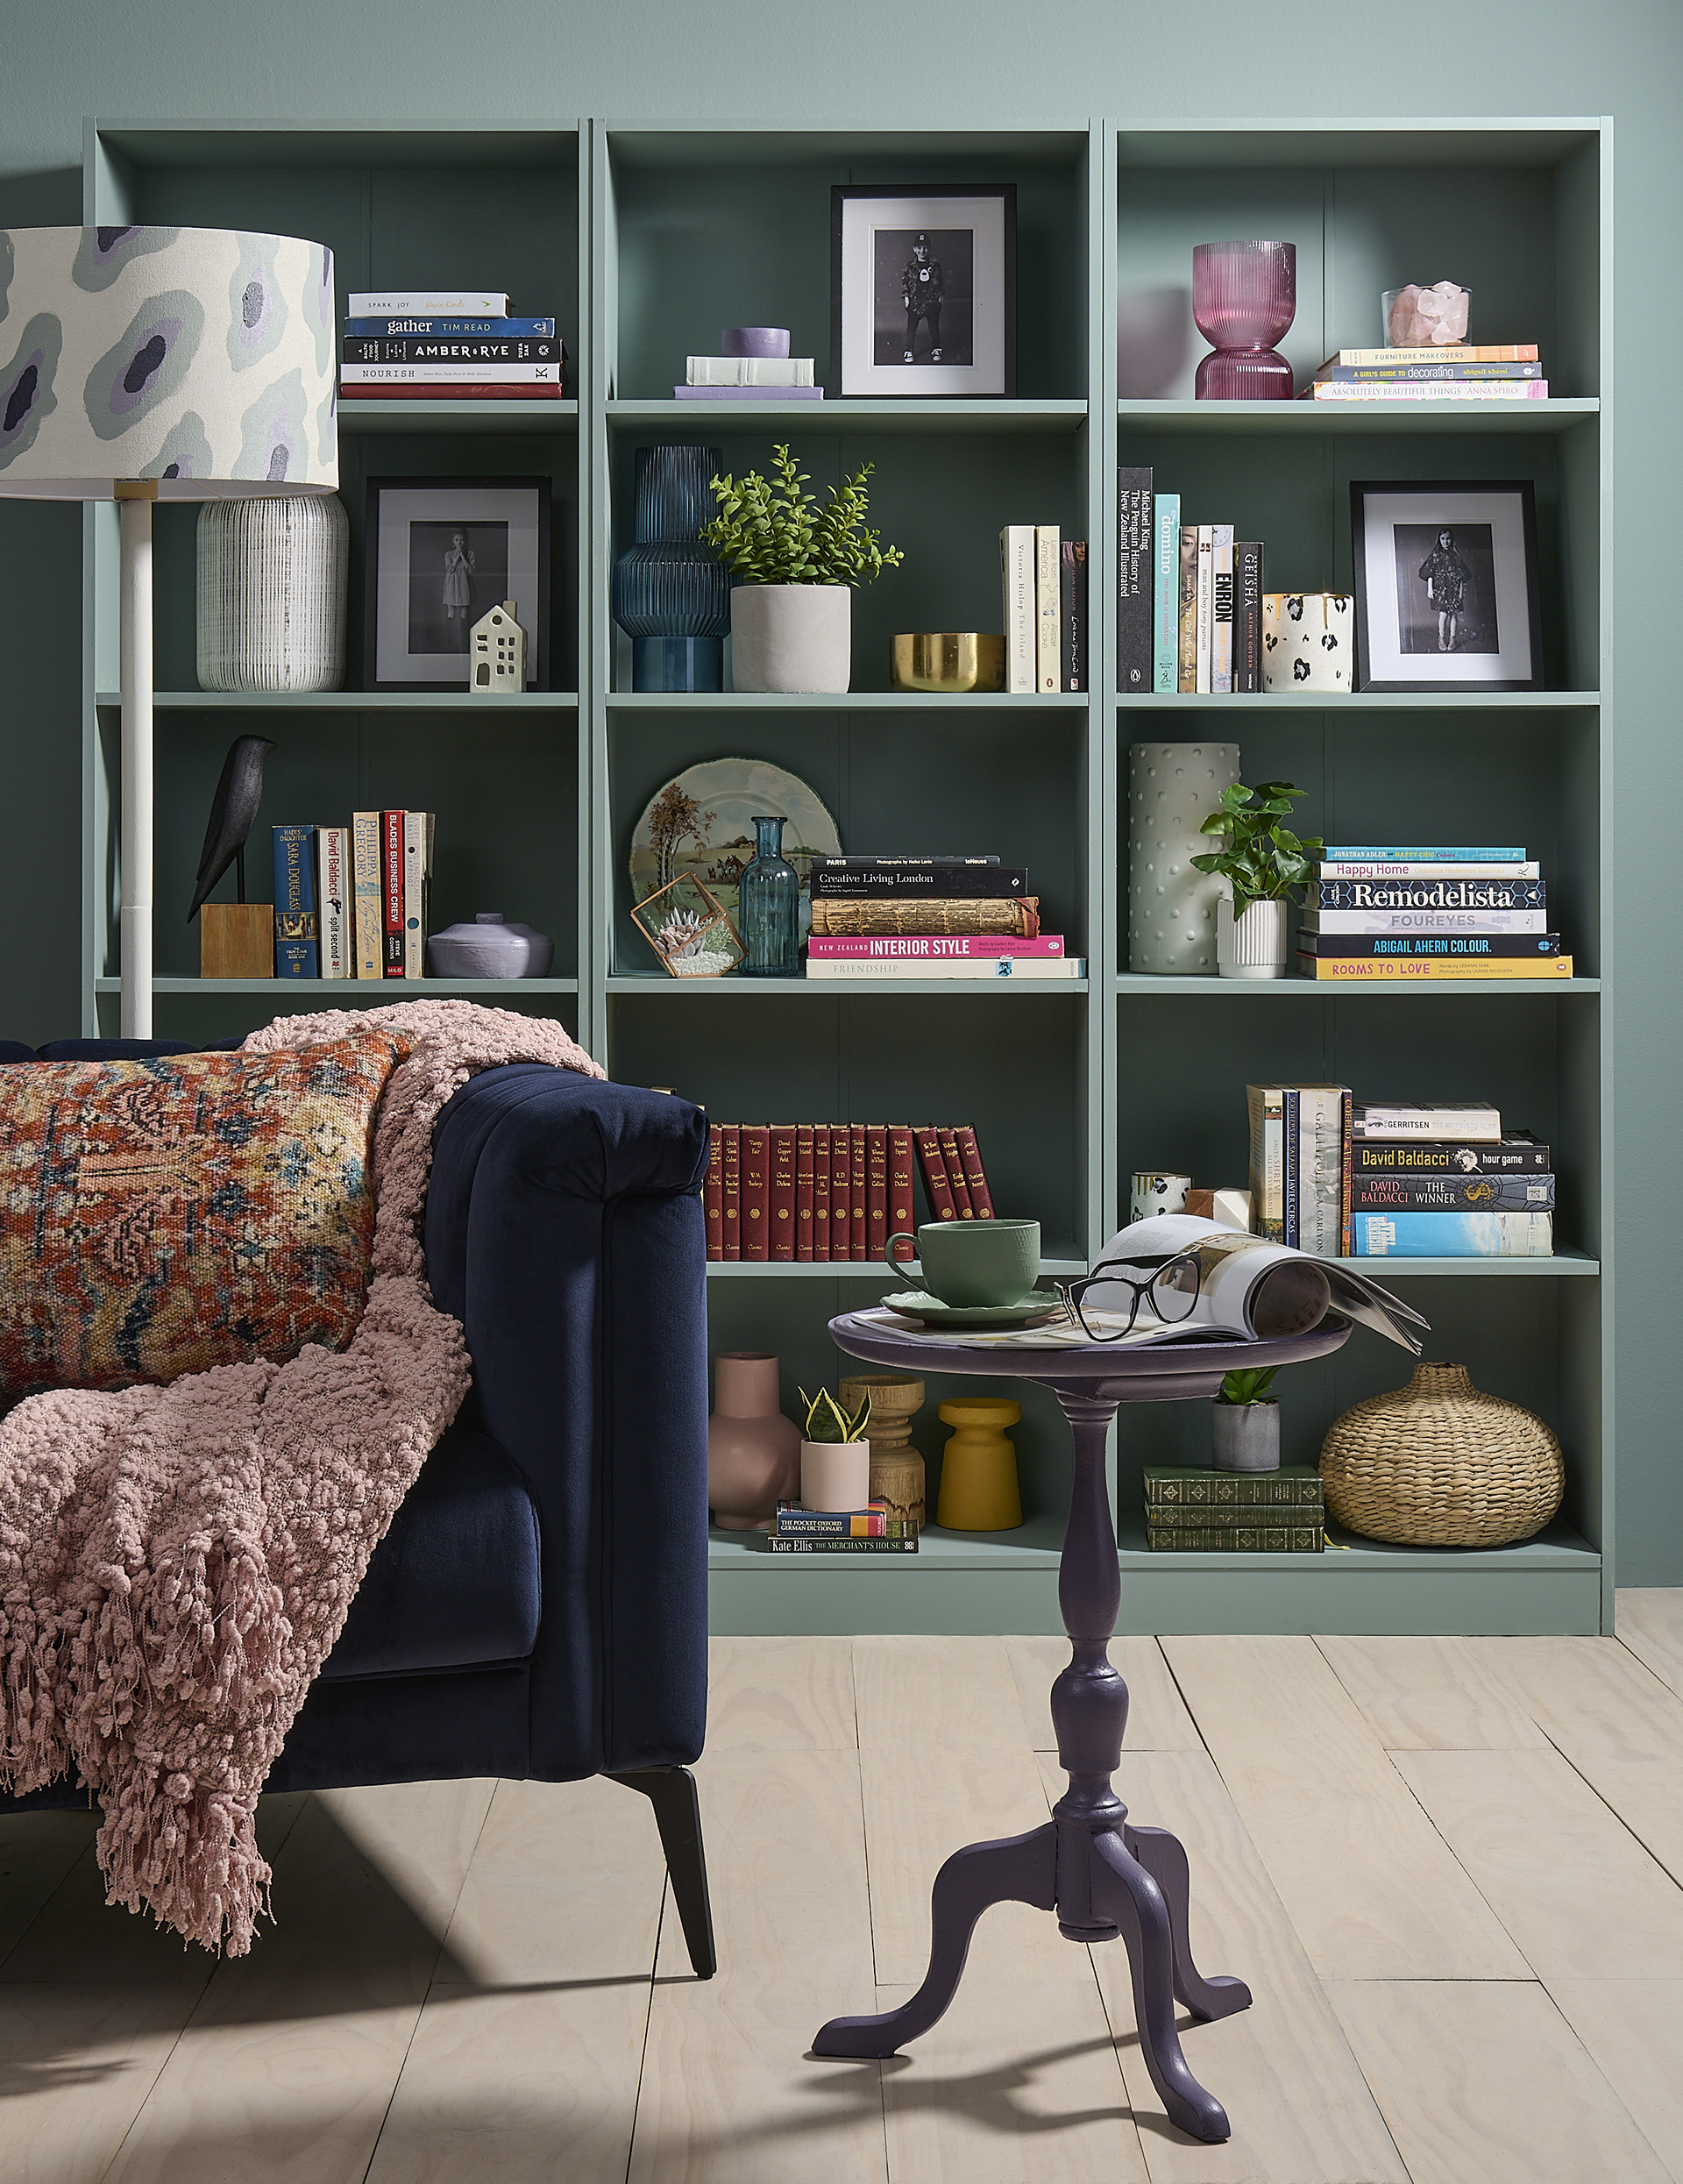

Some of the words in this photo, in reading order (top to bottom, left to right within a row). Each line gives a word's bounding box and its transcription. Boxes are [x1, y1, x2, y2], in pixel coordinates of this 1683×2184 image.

[387, 319, 433, 335] gather
[415, 345, 472, 358] AMBER
[479, 345, 509, 358] RYE
[536, 368, 547, 378] K
[1407, 366, 1454, 379] decorating
[1121, 490, 1129, 511] New
[1131, 490, 1140, 508] The
[1142, 490, 1150, 526] Michael
[1121, 513, 1129, 549] Zealand
[1129, 510, 1140, 547] Penguin
[1140, 529, 1150, 550] King
[1161, 516, 1174, 574] domino
[1040, 540, 1050, 578] America
[1129, 549, 1140, 582] History
[1121, 552, 1129, 597] Illustrated
[1245, 554, 1253, 607] GEISHA
[1131, 584, 1140, 594] of
[1215, 573, 1232, 622] ENRON
[1201, 598, 1209, 608] boy
[328, 832, 339, 856] David
[355, 818, 366, 877] GREGORY
[367, 820, 377, 876] PHILIPPA
[287, 843, 299, 865] SARA
[328, 858, 340, 895] Baldacci
[819, 874, 860, 883] Creative
[863, 874, 894, 885] Living
[896, 874, 934, 883] London
[1337, 864, 1373, 878] Happy
[1377, 864, 1409, 874] Home
[288, 868, 300, 911] DOUGLASS
[1352, 882, 1513, 907] Remodelista
[328, 917, 340, 932] split
[1391, 915, 1475, 926] FOUREYES
[330, 934, 340, 958] second
[870, 940, 929, 955] INTERIOR
[933, 939, 970, 954] STYLE
[1374, 940, 1413, 953] ABIGAIL
[1414, 940, 1448, 953] AHERN
[1450, 939, 1492, 953] COLOUR.
[1332, 964, 1374, 975] ROOMS
[1378, 964, 1393, 974] TO
[1400, 963, 1430, 974] LOVE
[1289, 1134, 1296, 1144] OF
[1315, 1112, 1326, 1184] GALLIPOLI
[1363, 1150, 1394, 1166] David
[1398, 1150, 1449, 1166] Baldacci
[1483, 1153, 1500, 1163] hour
[1502, 1156, 1523, 1166] game
[1370, 1181, 1400, 1191] DAVID
[1425, 1182, 1445, 1192] THE
[1316, 1199, 1323, 1207] A.
[1361, 1192, 1409, 1203] BALDACCI
[1415, 1193, 1456, 1203] WINNER
[772, 1540, 792, 1552] Kate
[794, 1540, 813, 1551] Ellis
